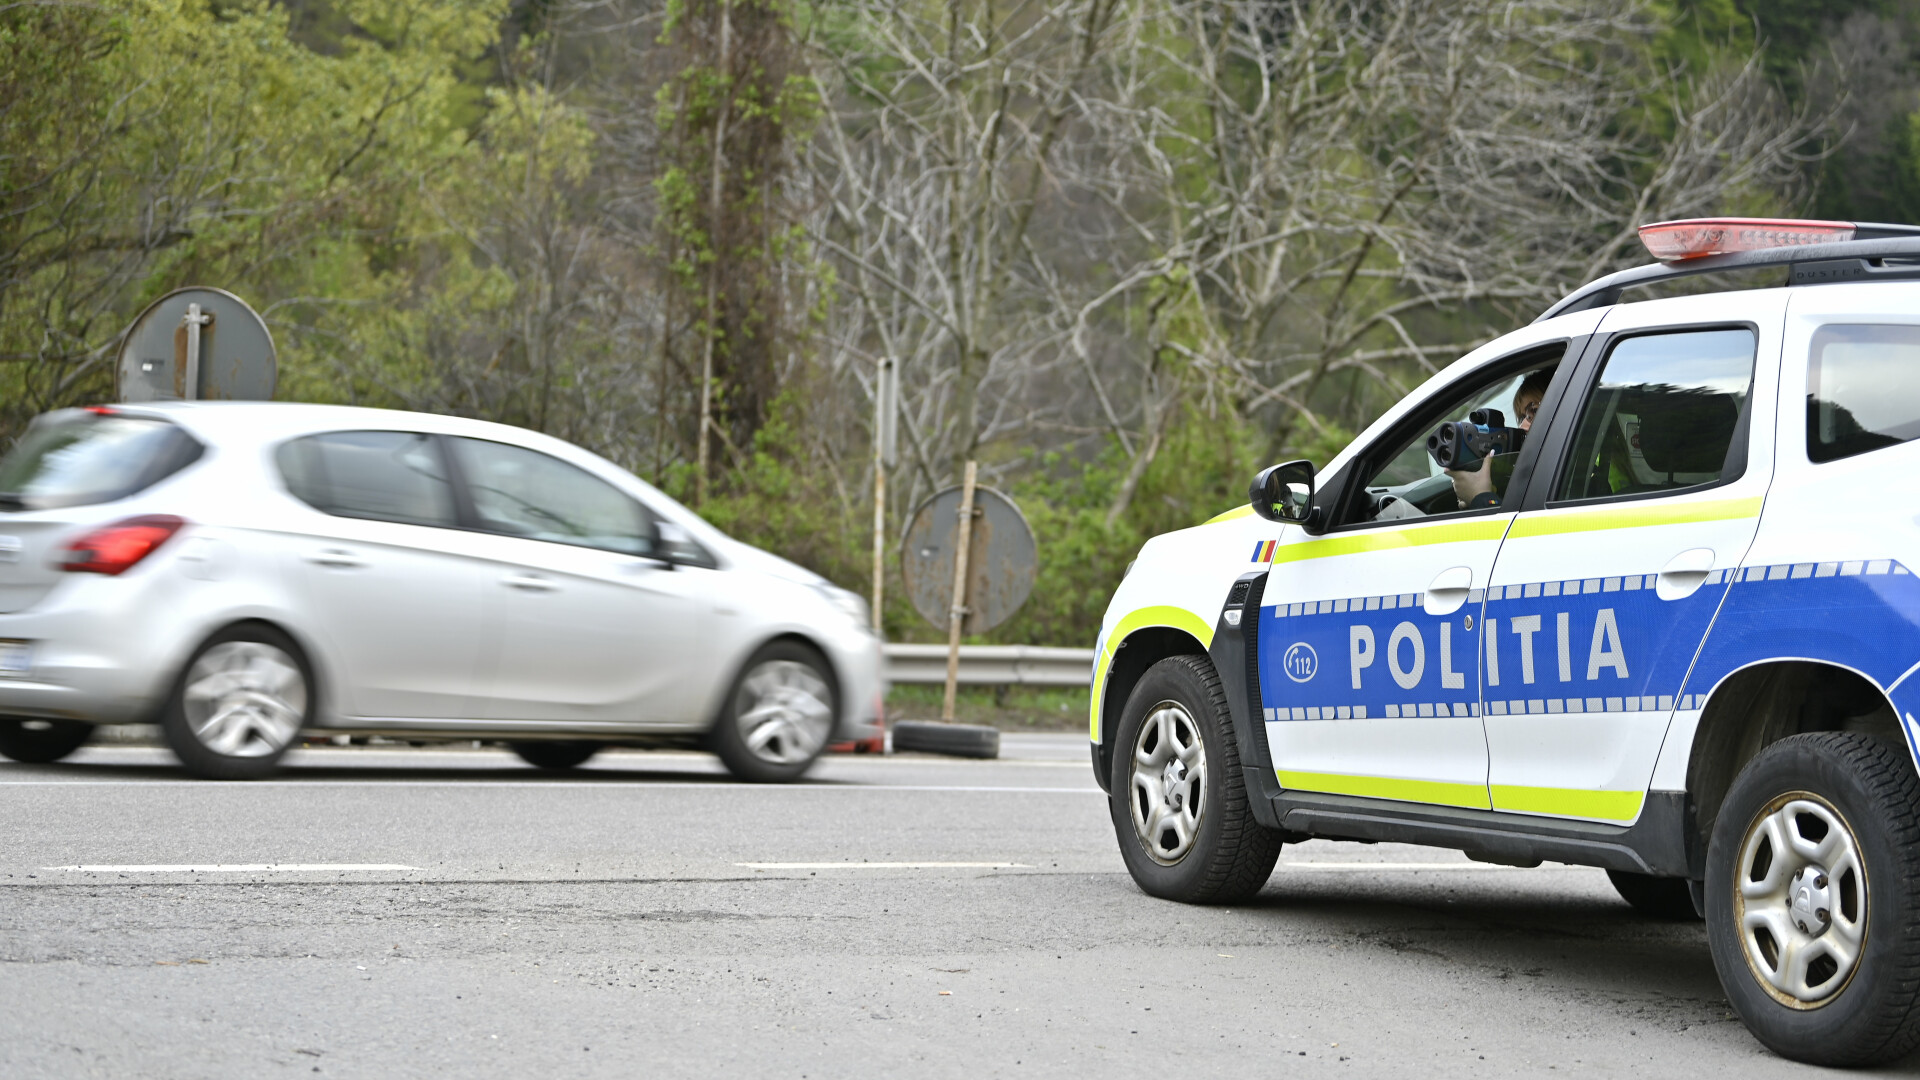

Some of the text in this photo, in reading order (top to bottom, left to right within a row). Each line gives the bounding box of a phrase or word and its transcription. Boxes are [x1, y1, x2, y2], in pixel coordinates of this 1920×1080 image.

[1796, 268, 1861, 279] DUSTER
[1349, 608, 1630, 690] POLITIA
[1295, 657, 1311, 675] 112
